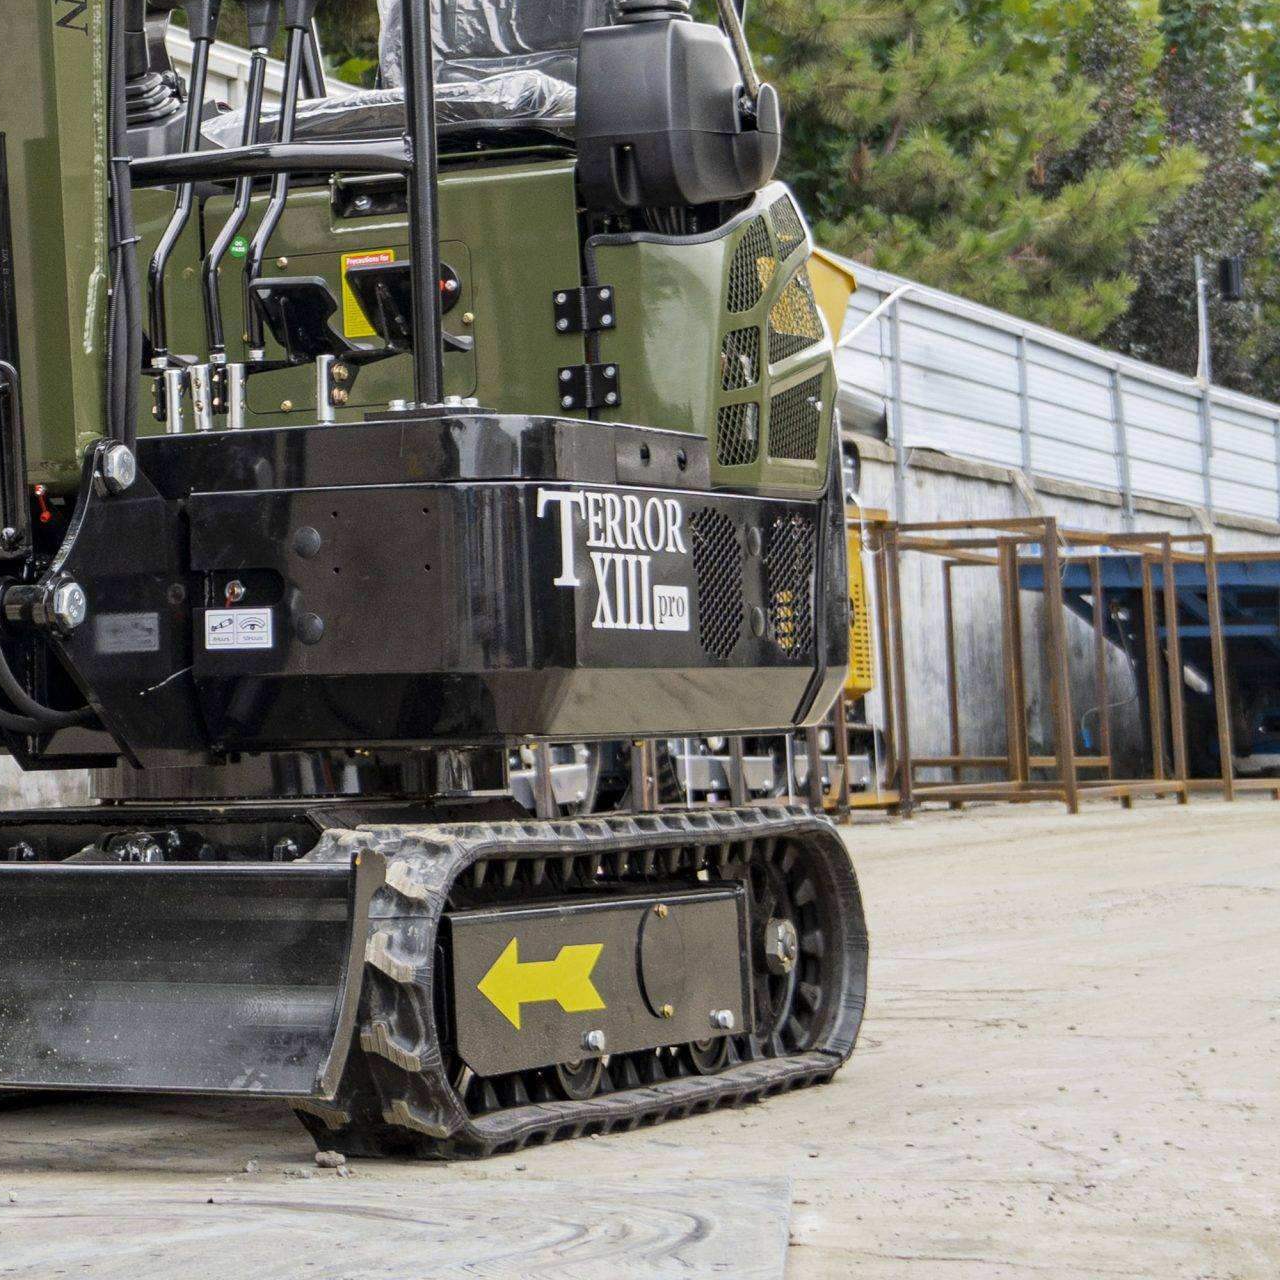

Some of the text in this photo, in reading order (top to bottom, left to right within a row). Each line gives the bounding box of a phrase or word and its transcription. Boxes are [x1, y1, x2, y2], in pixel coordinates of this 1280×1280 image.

[346, 255, 380, 265] Precautions
[536, 487, 687, 587] TERROR
[589, 551, 685, 631] XIII pro
